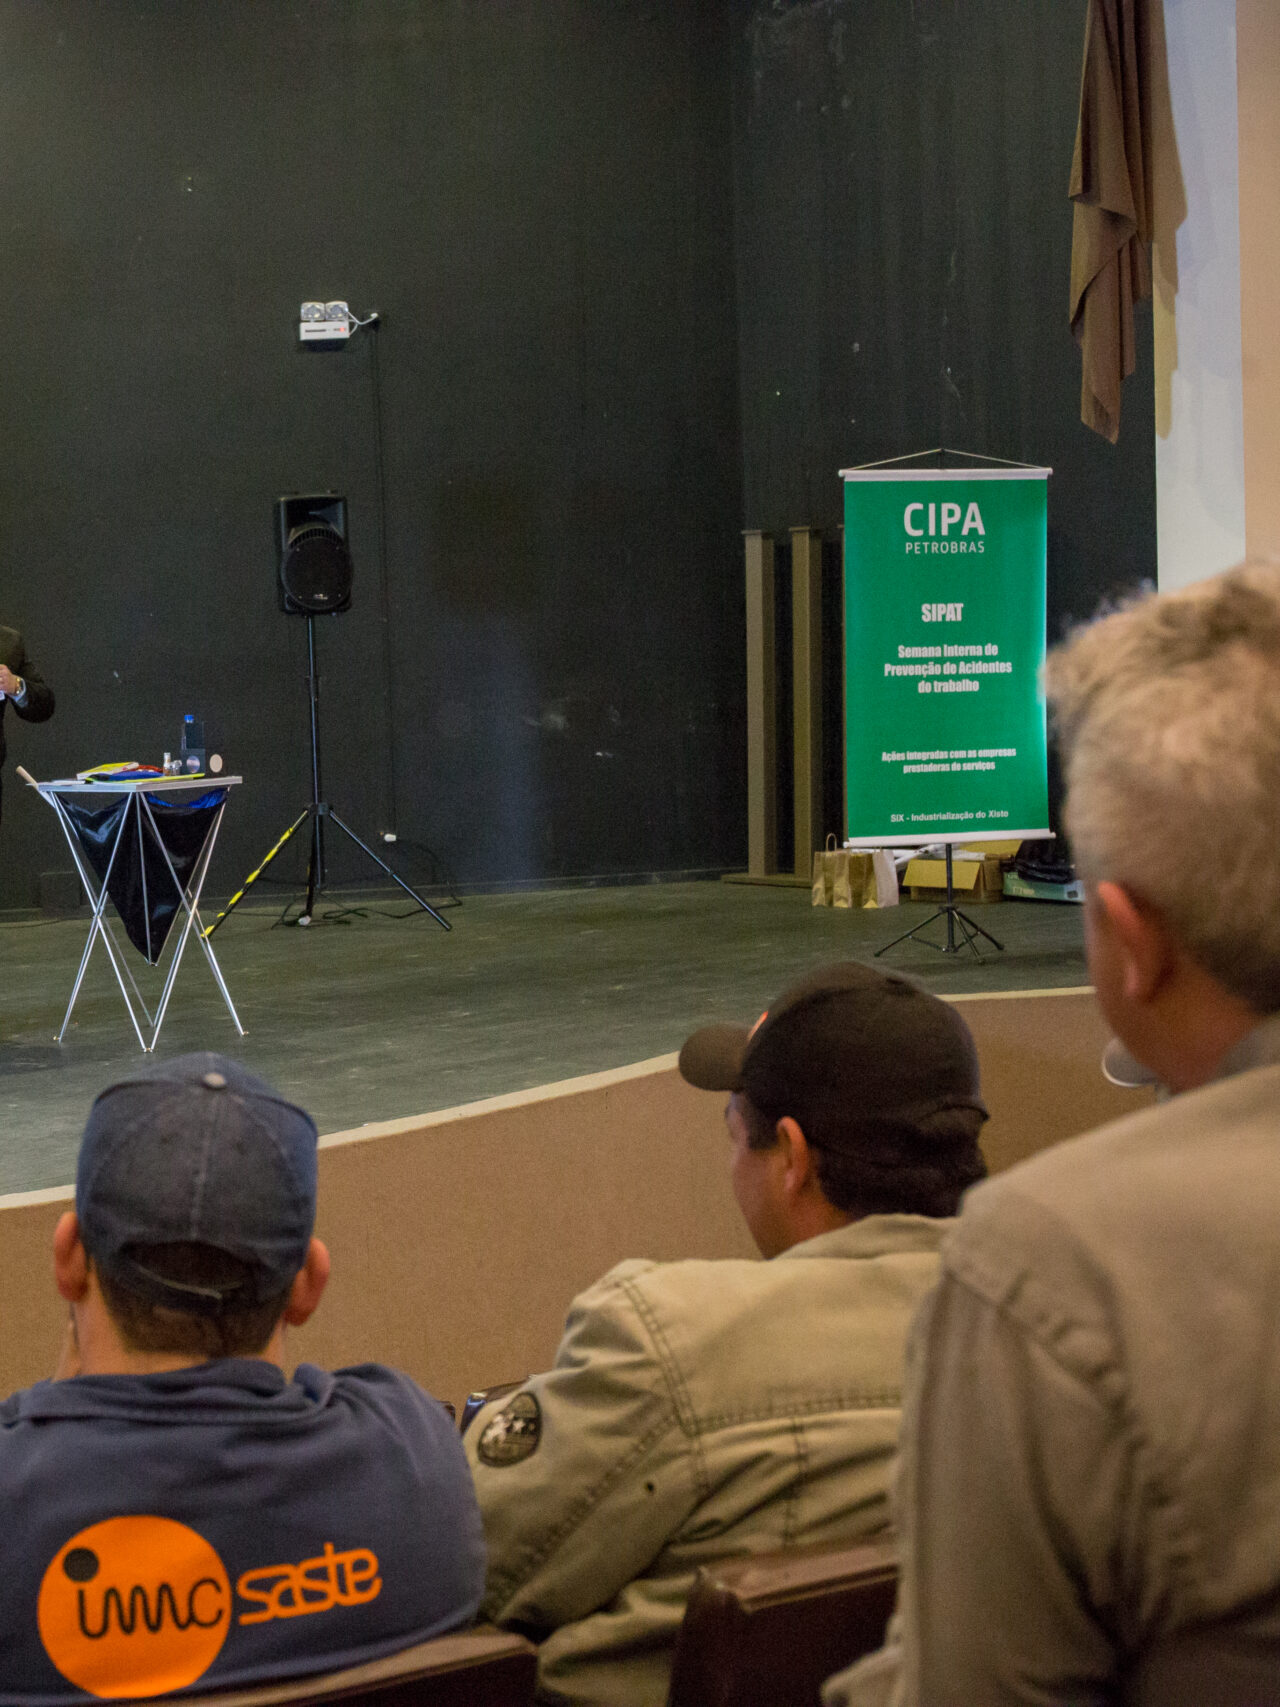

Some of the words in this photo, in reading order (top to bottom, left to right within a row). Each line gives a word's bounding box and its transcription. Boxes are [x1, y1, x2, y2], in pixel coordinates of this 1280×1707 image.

[903, 502, 986, 537] CIPA
[905, 541, 985, 555] PETROBRAS
[921, 603, 963, 622] SIPAT
[898, 645, 941, 658] Semana
[943, 644, 982, 657] Interna
[984, 643, 998, 656] de
[884, 662, 941, 677] Prevenção
[943, 662, 957, 674] de
[959, 661, 1012, 674] Acidentes
[918, 681, 932, 693] do
[934, 679, 979, 692] trabalho
[882, 751, 905, 762] Ações
[907, 750, 948, 761] integradas
[950, 750, 966, 758] com
[968, 749, 976, 758] as
[978, 748, 1016, 758] empresas
[903, 763, 950, 774] prestadoras
[951, 762, 961, 771] de
[963, 761, 995, 771] serviços
[891, 814, 904, 822] SIX
[911, 812, 974, 821] Industrialização
[988, 810, 1008, 818] Xisto
[237, 1542, 383, 1626] saste
